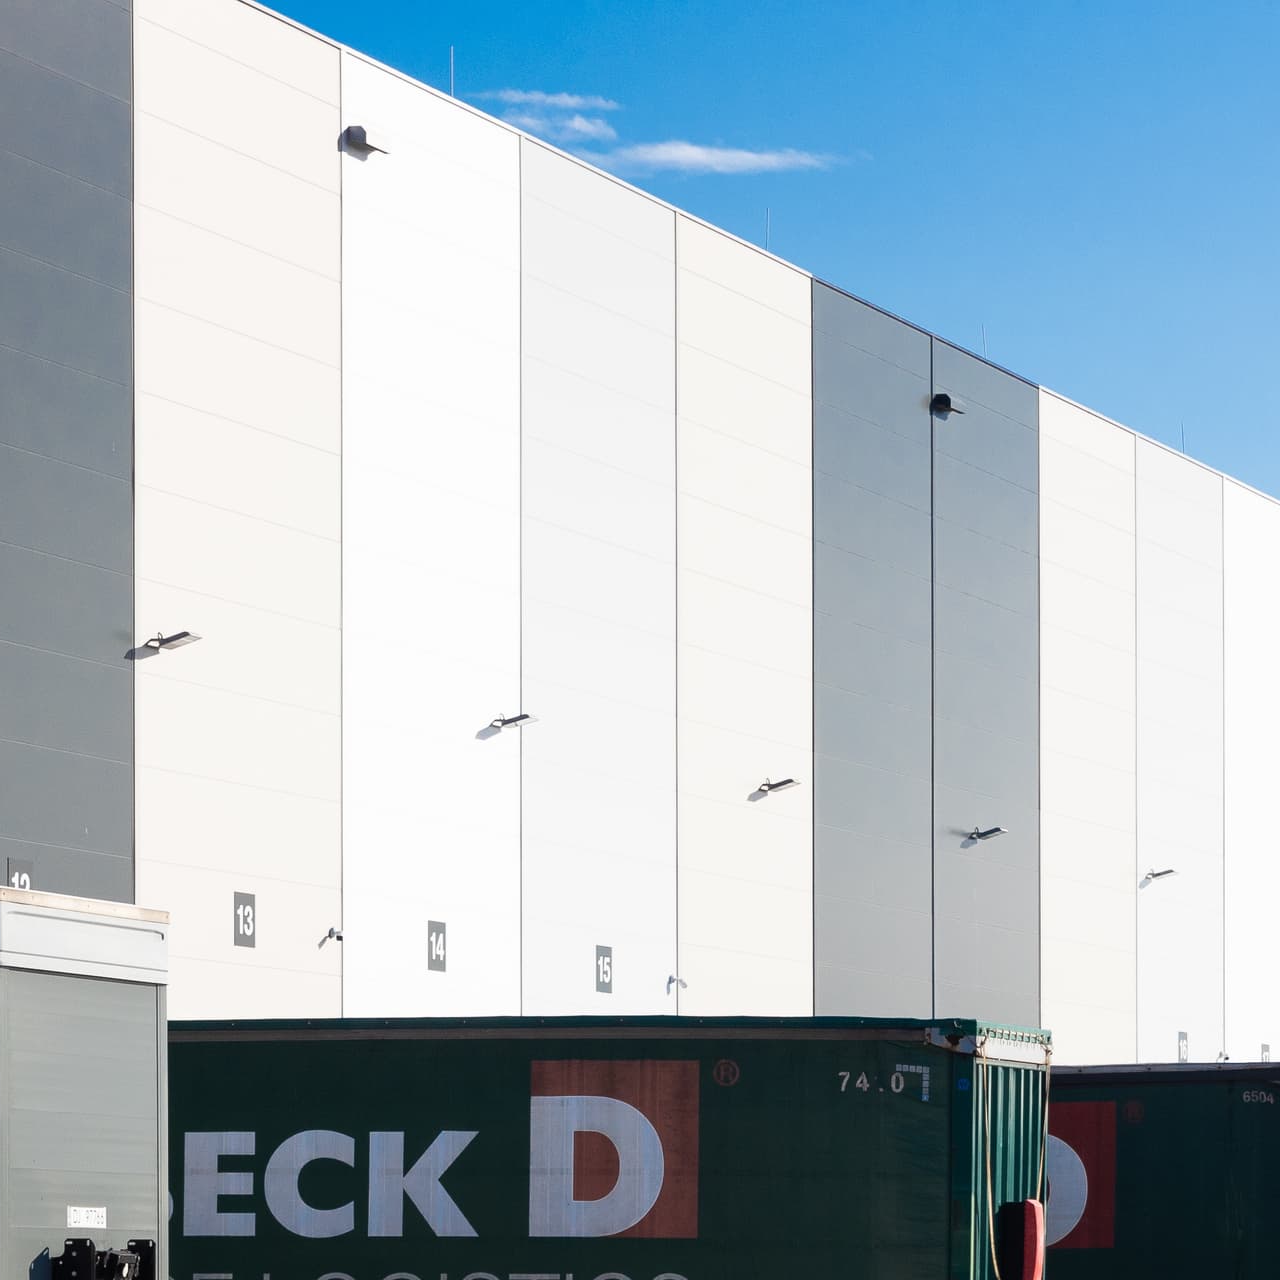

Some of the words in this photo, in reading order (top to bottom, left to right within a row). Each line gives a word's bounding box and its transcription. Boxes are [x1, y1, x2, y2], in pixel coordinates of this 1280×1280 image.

[236, 904, 254, 937] 13
[430, 932, 445, 961] 14
[598, 955, 611, 984] 15
[169, 1129, 480, 1239] ECK
